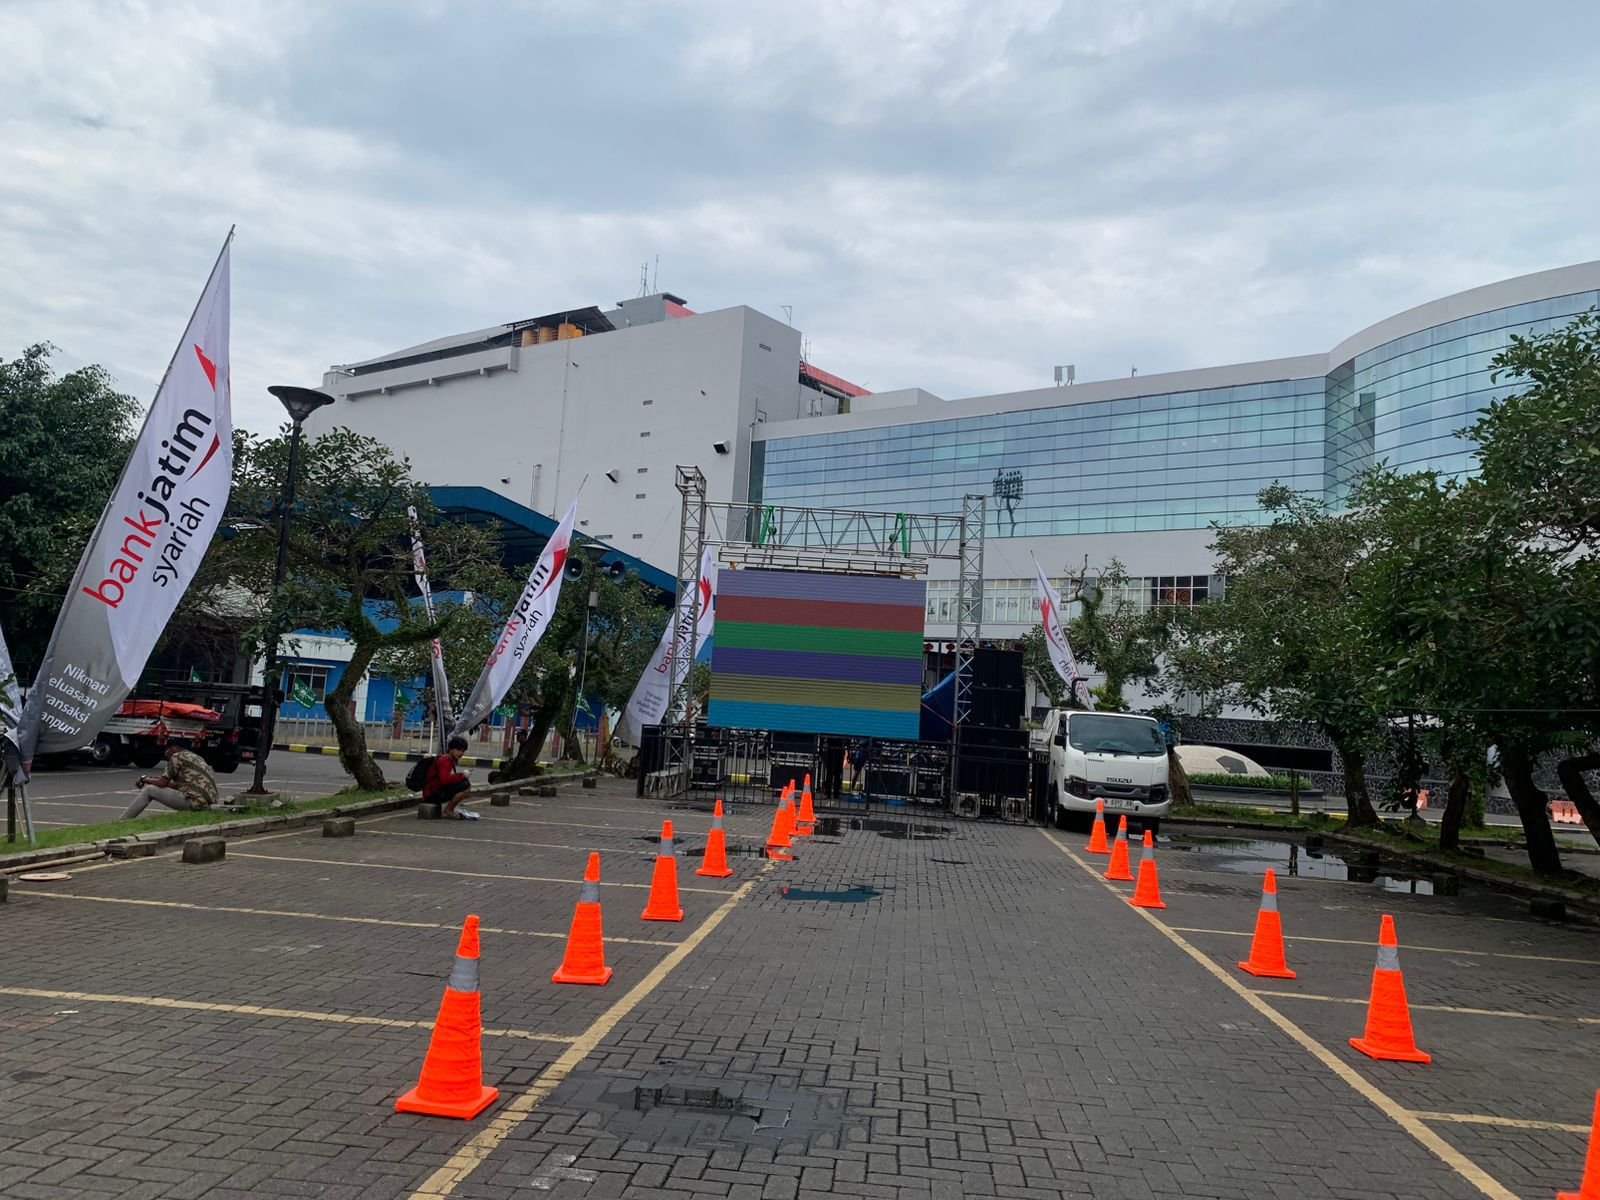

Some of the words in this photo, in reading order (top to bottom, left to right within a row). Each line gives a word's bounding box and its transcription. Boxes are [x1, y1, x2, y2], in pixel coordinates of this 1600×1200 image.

[153, 497, 211, 587] syariah
[48, 677, 98, 710] eluasaan
[63, 663, 111, 696] Nikmati
[45, 693, 91, 724] ransaksi
[1106, 776, 1133, 784] ISUZU
